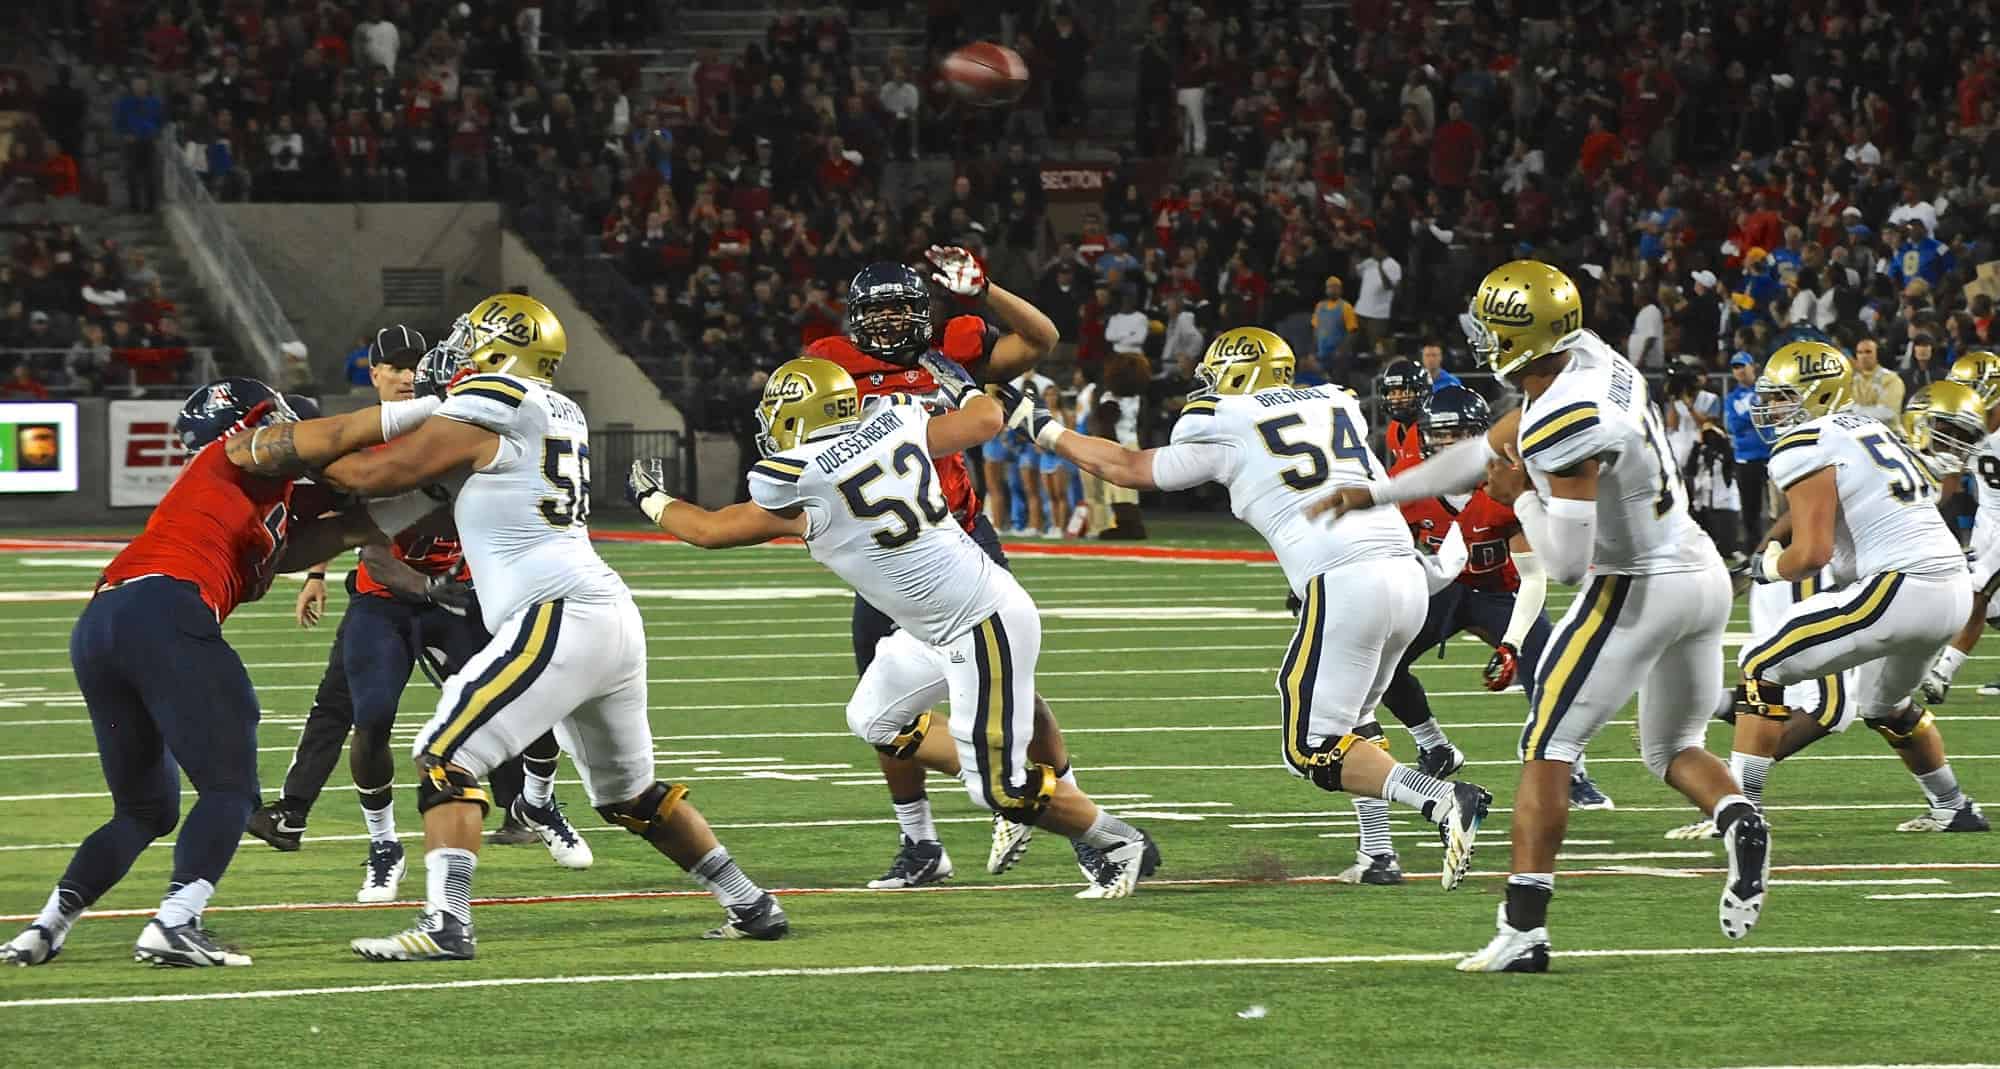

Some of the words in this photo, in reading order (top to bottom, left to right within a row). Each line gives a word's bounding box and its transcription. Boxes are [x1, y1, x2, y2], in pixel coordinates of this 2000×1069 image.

[1040, 169, 1102, 190] SECTION
[1562, 309, 1578, 334] 17
[837, 397, 857, 418] 52
[1255, 387, 1332, 408] BRENDEL
[815, 409, 905, 475] QUESSENBERRY
[1256, 406, 1377, 492] 54
[836, 441, 949, 549] 52
